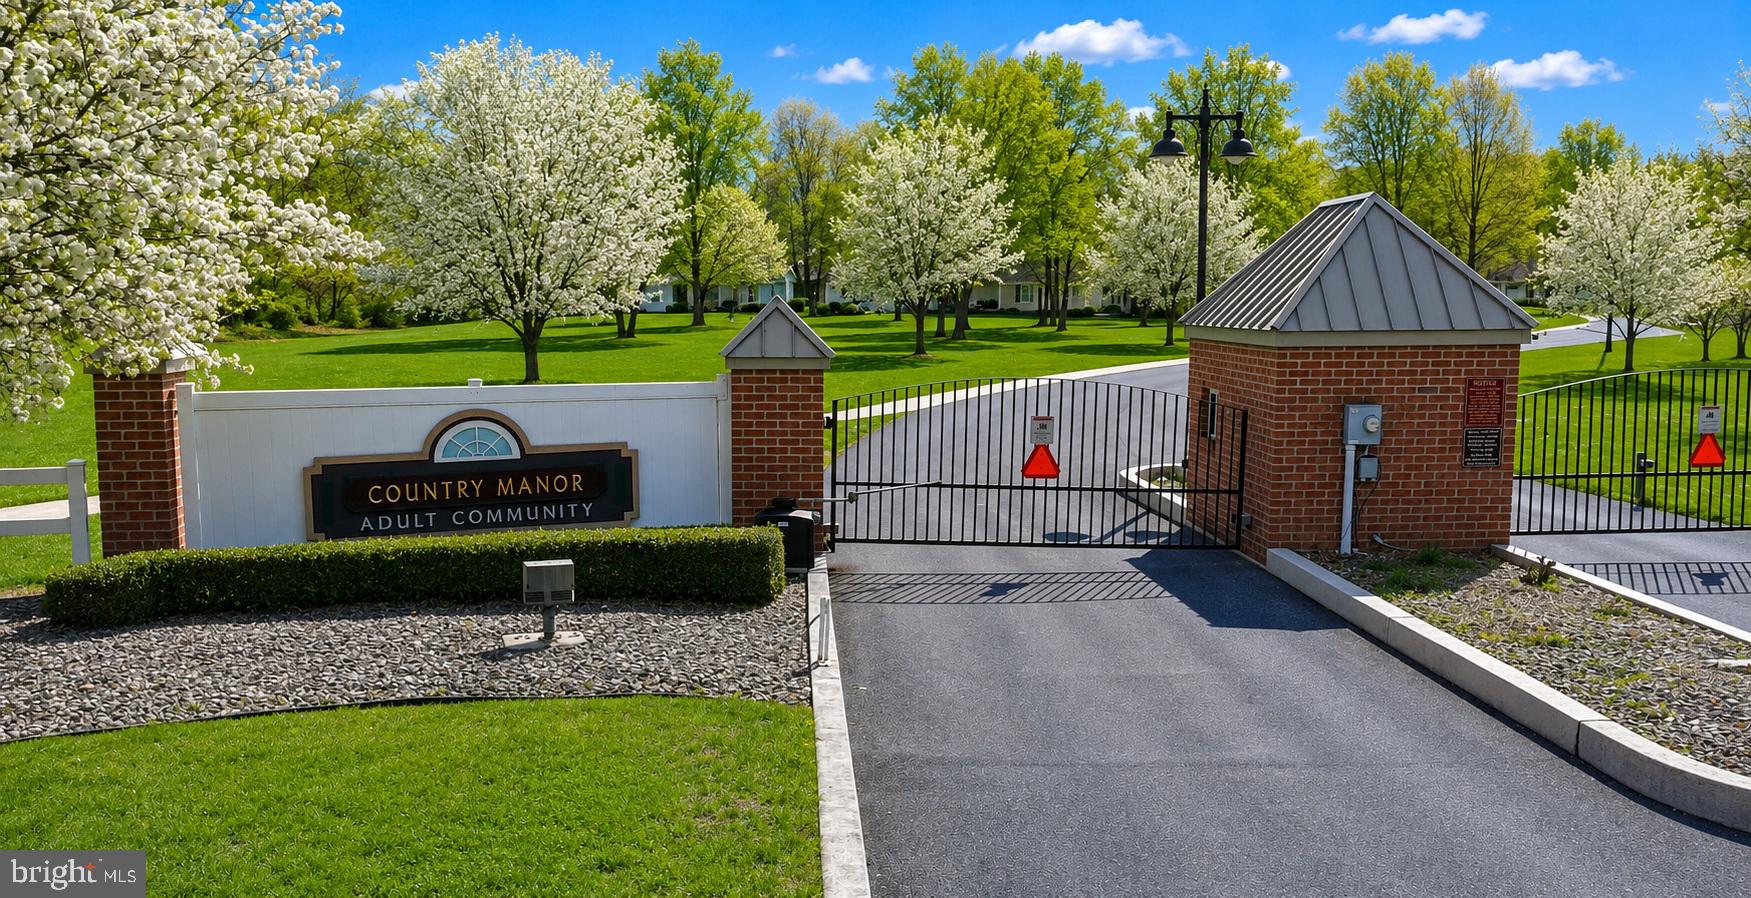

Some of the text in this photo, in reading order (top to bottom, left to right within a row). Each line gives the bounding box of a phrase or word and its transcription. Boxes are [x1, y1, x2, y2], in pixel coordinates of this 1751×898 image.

[368, 473, 584, 504] COUNTRY MANOR
[360, 502, 593, 532] ADULT COMMUNITY
